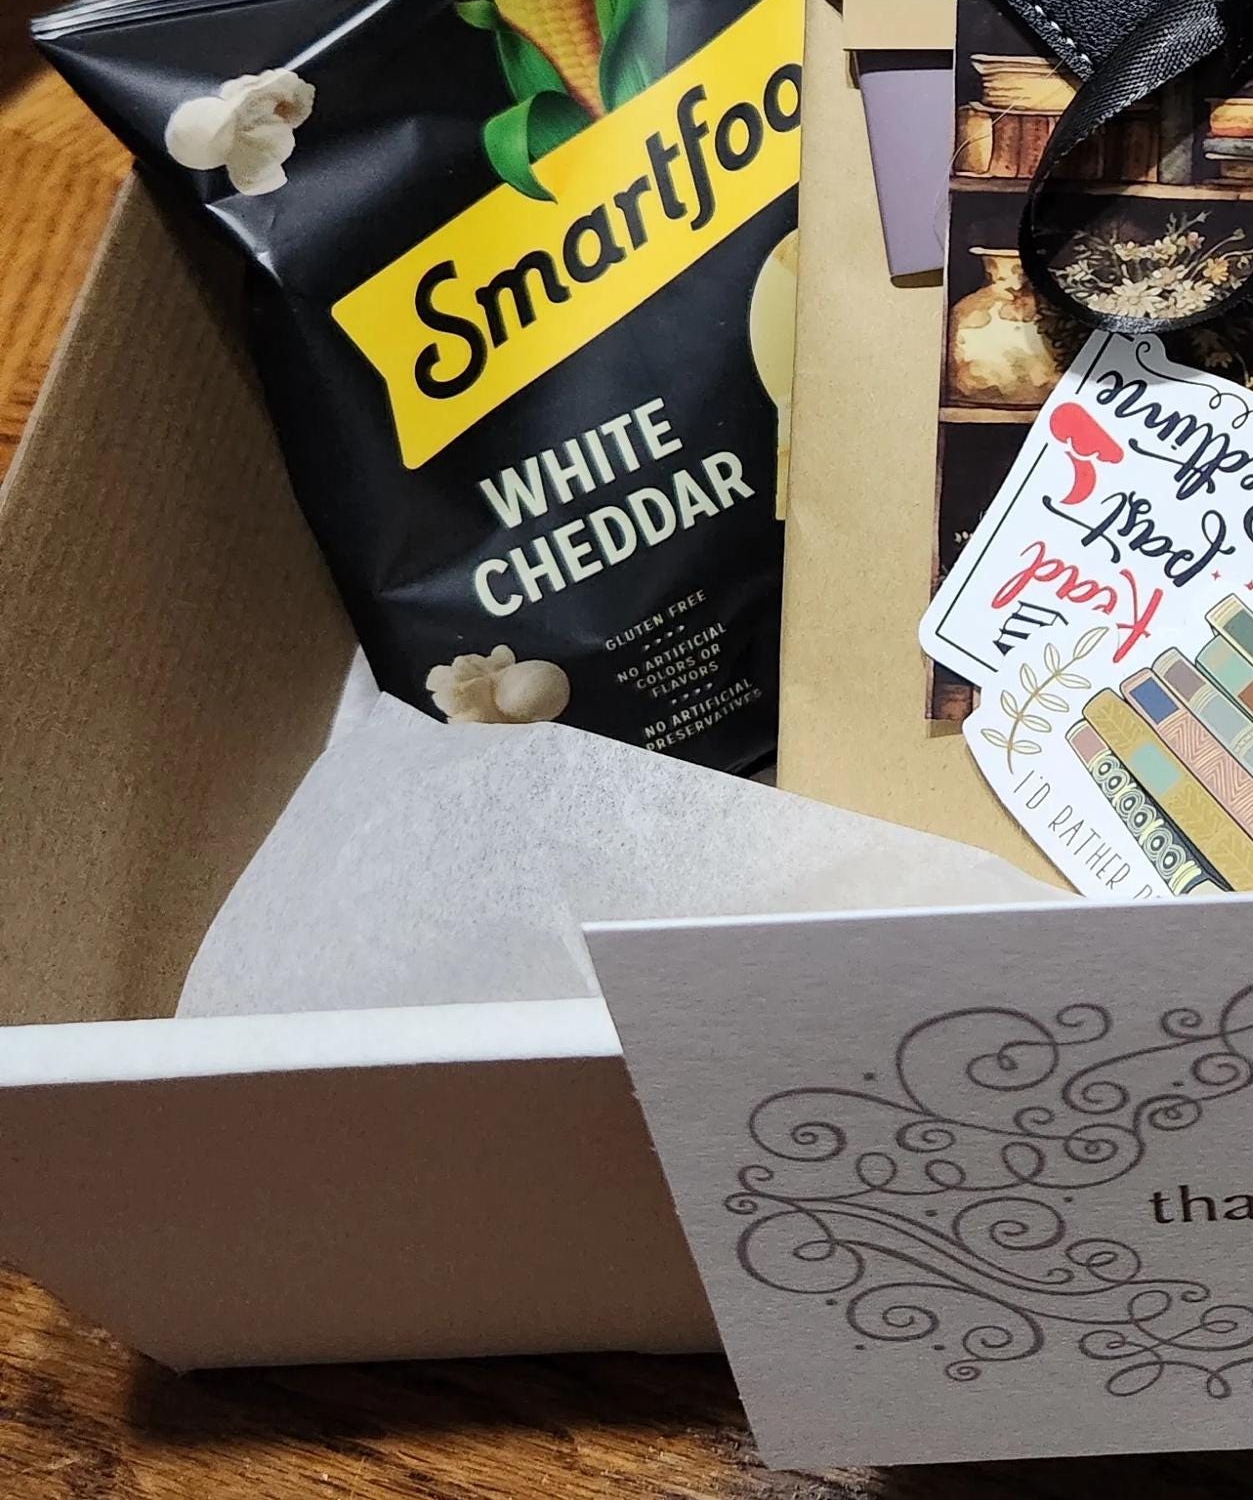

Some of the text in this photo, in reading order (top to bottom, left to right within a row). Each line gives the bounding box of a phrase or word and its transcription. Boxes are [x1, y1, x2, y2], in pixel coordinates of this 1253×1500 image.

[414, 63, 803, 399] Smartfoo
[480, 398, 684, 531] WHITE
[474, 450, 756, 619] CHEDDAR
[1042, 490, 1236, 588] past
[605, 589, 706, 651] GLUTEN FREE
[617, 622, 727, 683] NO ARTIFICIAL
[636, 643, 722, 689] COLORS OR
[651, 661, 719, 698] FLAVORS
[644, 678, 753, 738] NO ARTIFICIAL
[1014, 770, 1131, 890] I'D RATHER
